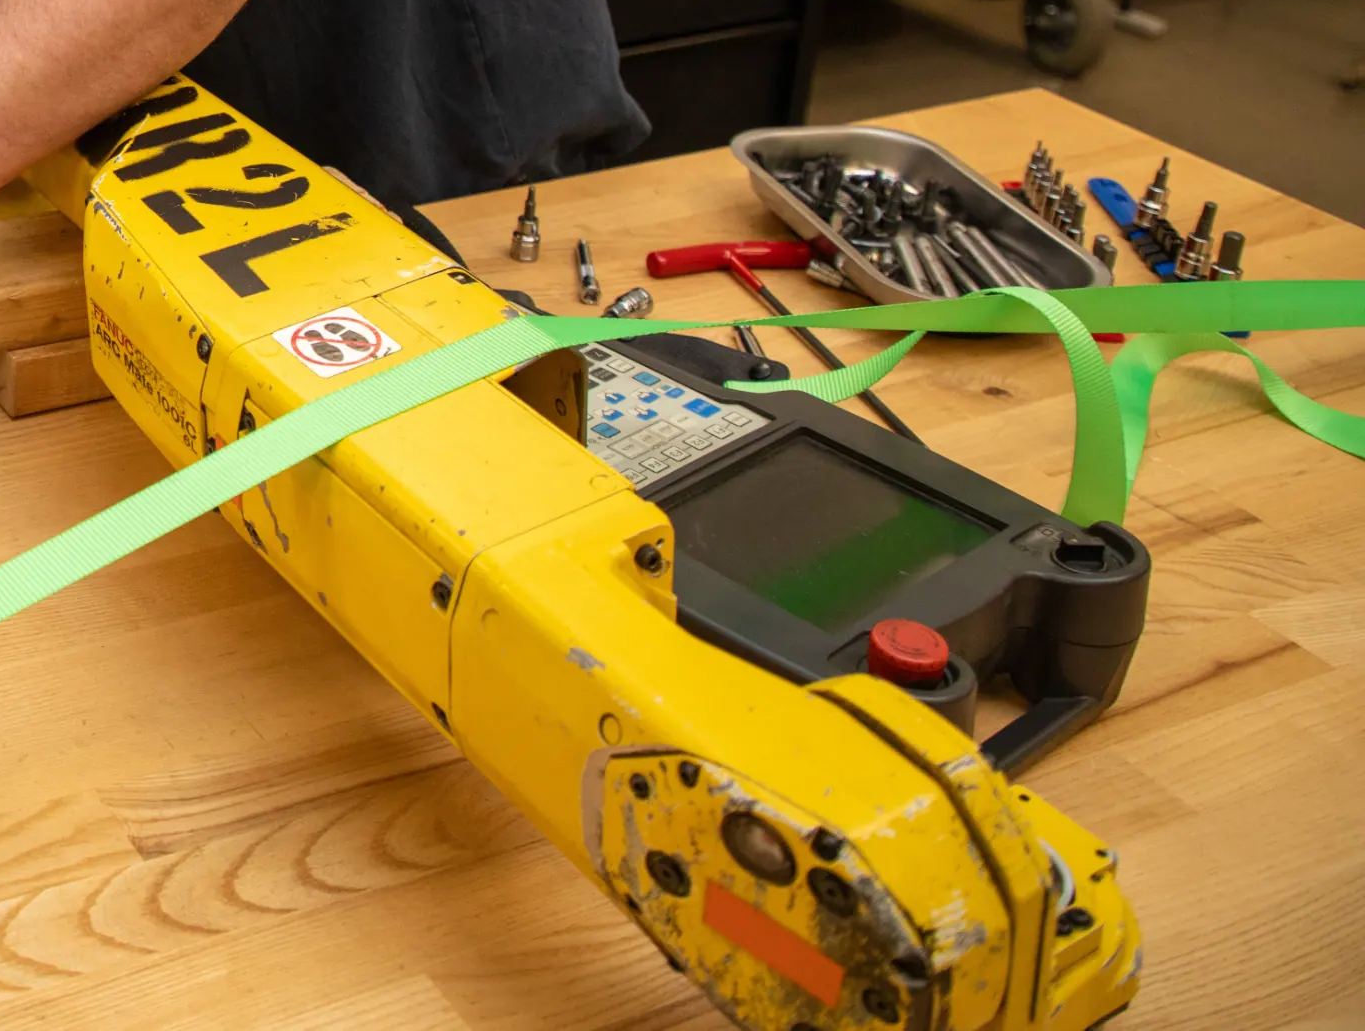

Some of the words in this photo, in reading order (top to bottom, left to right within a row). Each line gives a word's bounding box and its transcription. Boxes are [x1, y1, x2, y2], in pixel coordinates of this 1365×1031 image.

[92, 303, 135, 357] FANUC
[95, 323, 121, 358] ARC
[124, 354, 154, 396] Mate
